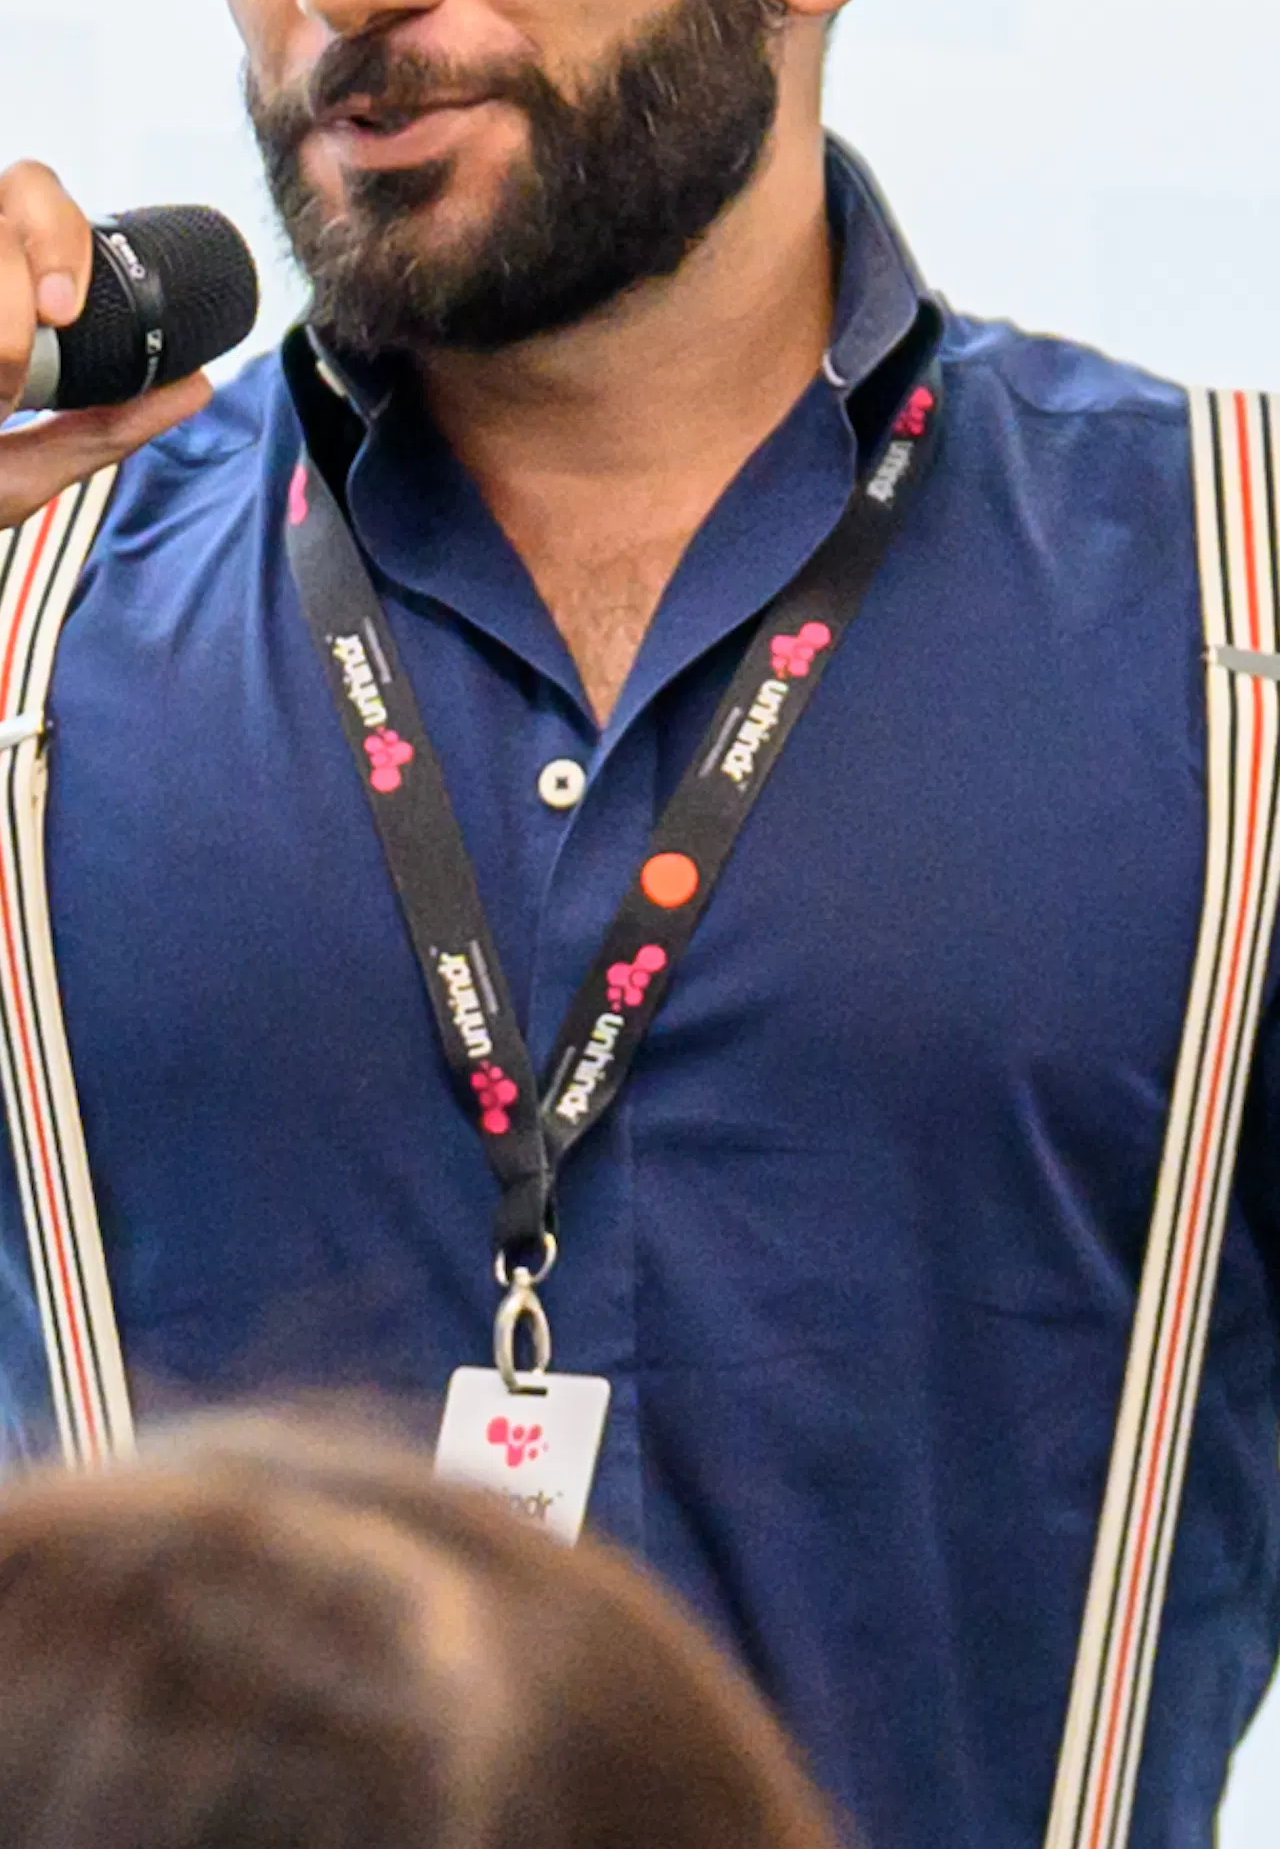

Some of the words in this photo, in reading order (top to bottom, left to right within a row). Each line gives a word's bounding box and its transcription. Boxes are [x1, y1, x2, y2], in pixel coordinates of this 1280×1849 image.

[331, 633, 387, 728] unhindr
[720, 678, 787, 781] unhindr
[437, 950, 492, 1059] unhindr
[555, 1012, 624, 1124] unhindr
